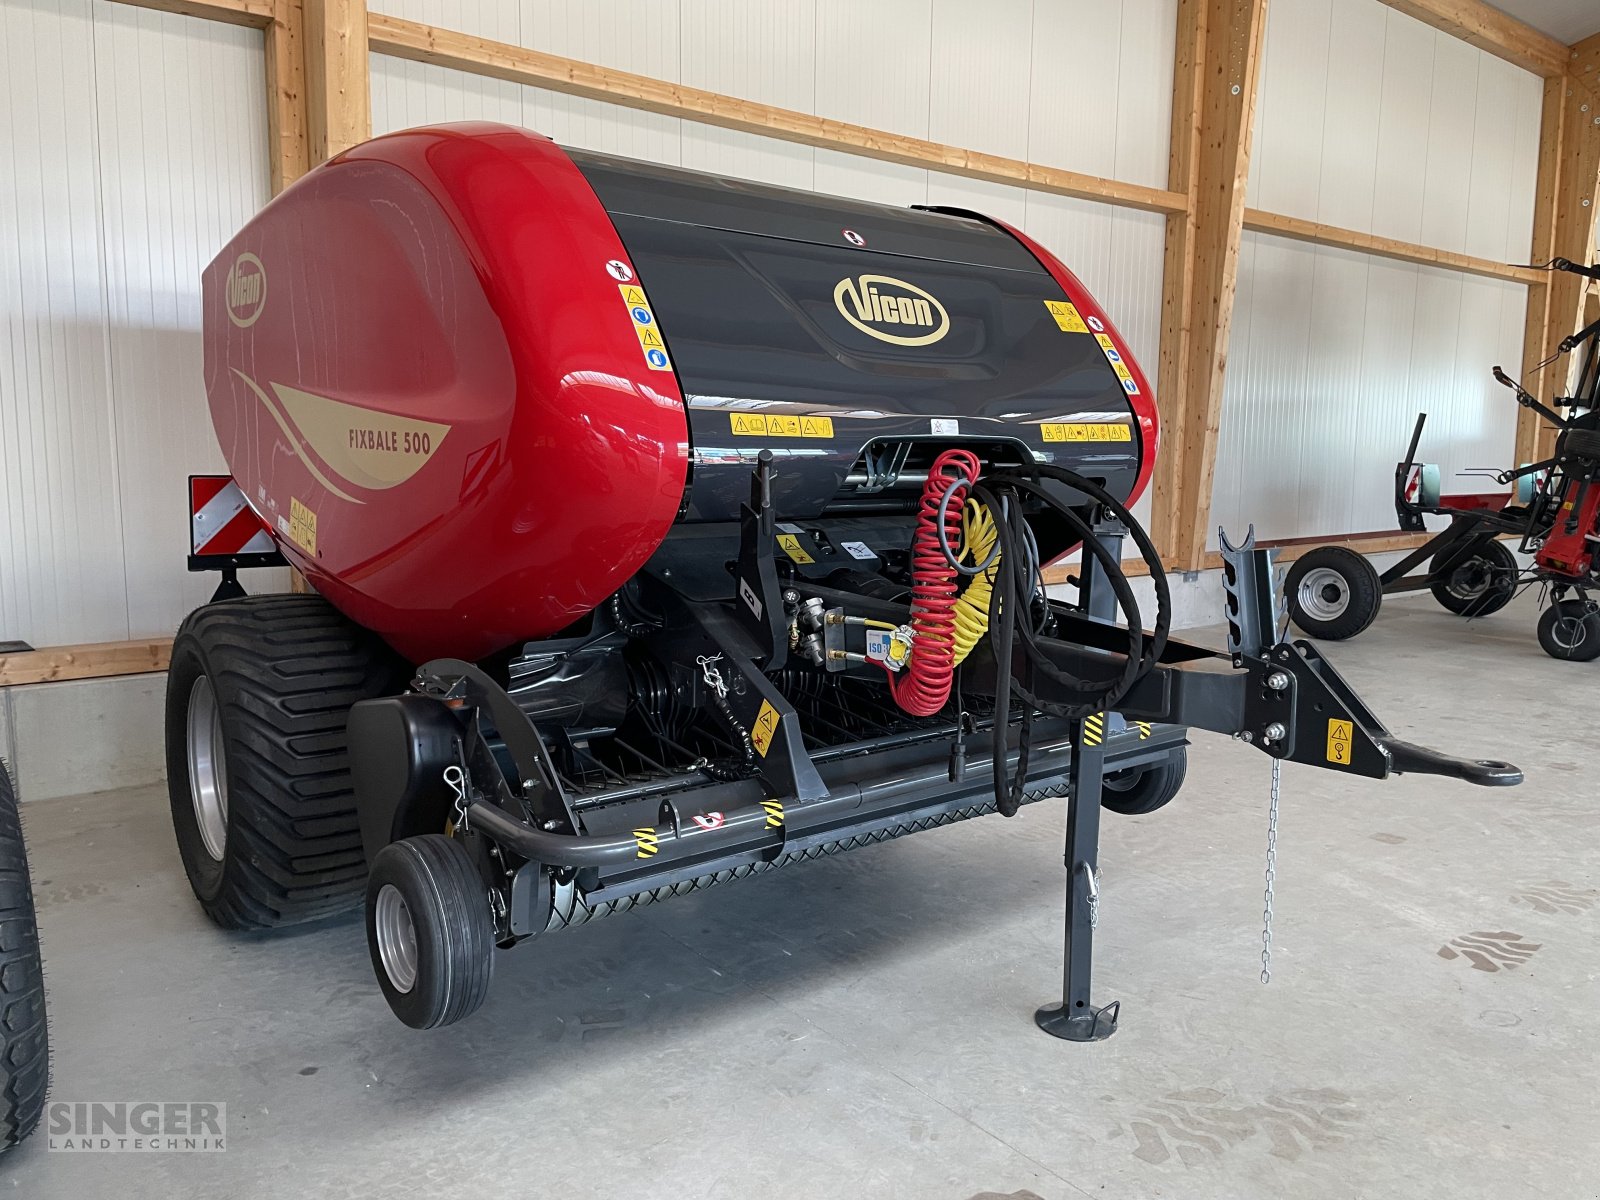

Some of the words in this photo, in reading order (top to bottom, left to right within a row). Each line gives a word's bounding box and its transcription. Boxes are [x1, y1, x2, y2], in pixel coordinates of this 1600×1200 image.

[227, 253, 261, 309] Vicon
[834, 274, 934, 328] Vicon
[349, 429, 398, 452] FIXBALE
[404, 432, 430, 455] 500
